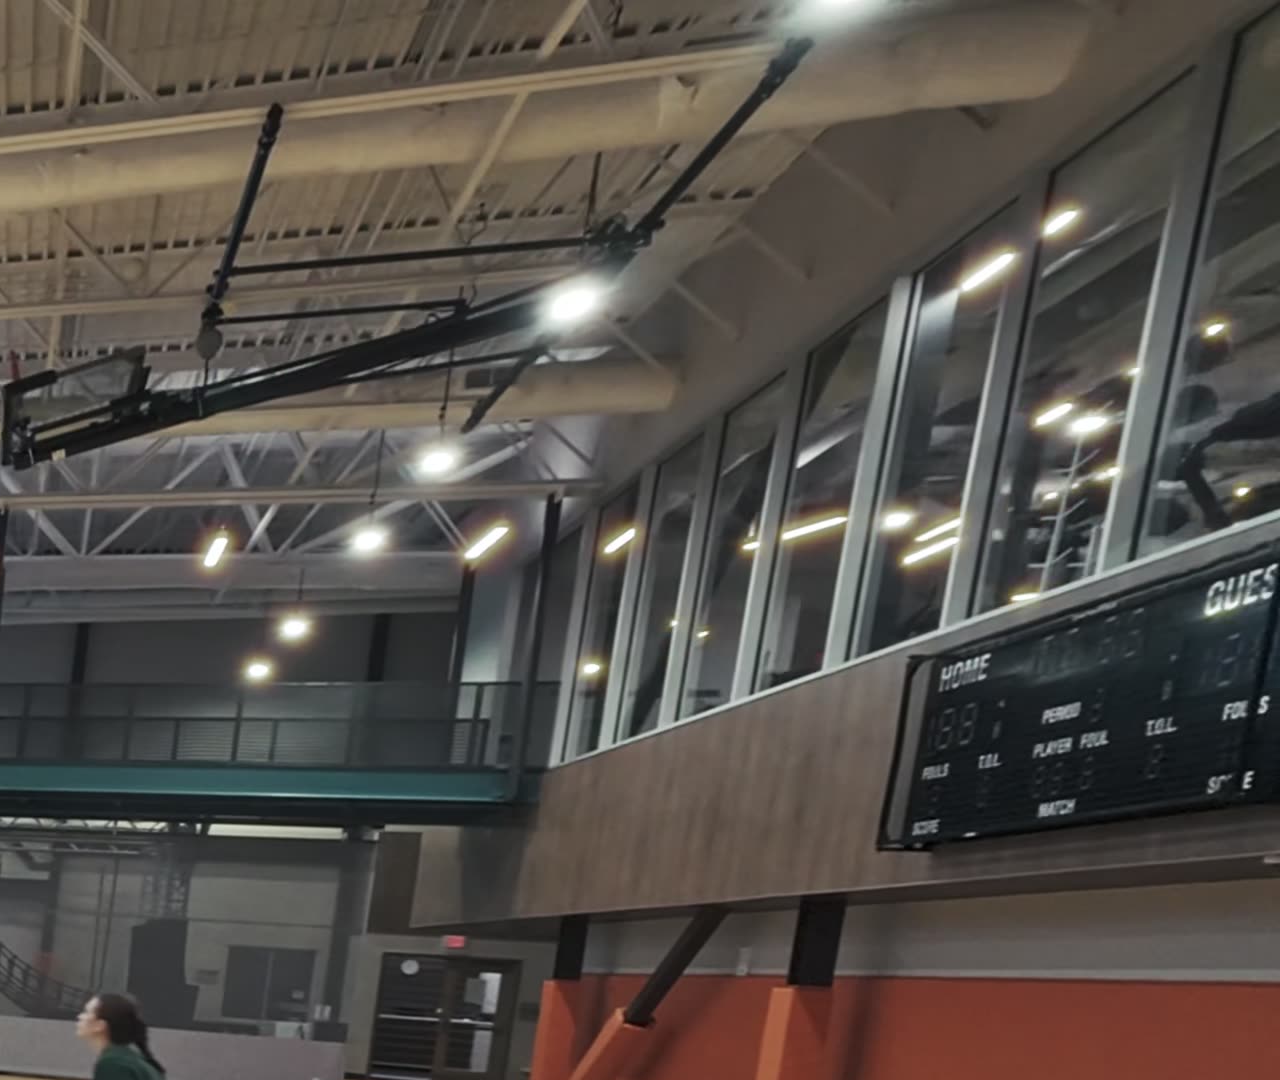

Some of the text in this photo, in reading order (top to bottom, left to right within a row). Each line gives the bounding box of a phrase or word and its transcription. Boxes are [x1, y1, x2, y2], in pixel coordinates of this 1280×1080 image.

[1204, 563, 1279, 616] GUES
[938, 653, 992, 692] HOME
[1041, 701, 1083, 725] PERIOD
[1222, 695, 1271, 721] FOUS
[1032, 730, 1110, 759] PLAYER FOUL
[1037, 798, 1077, 818] MATCH
